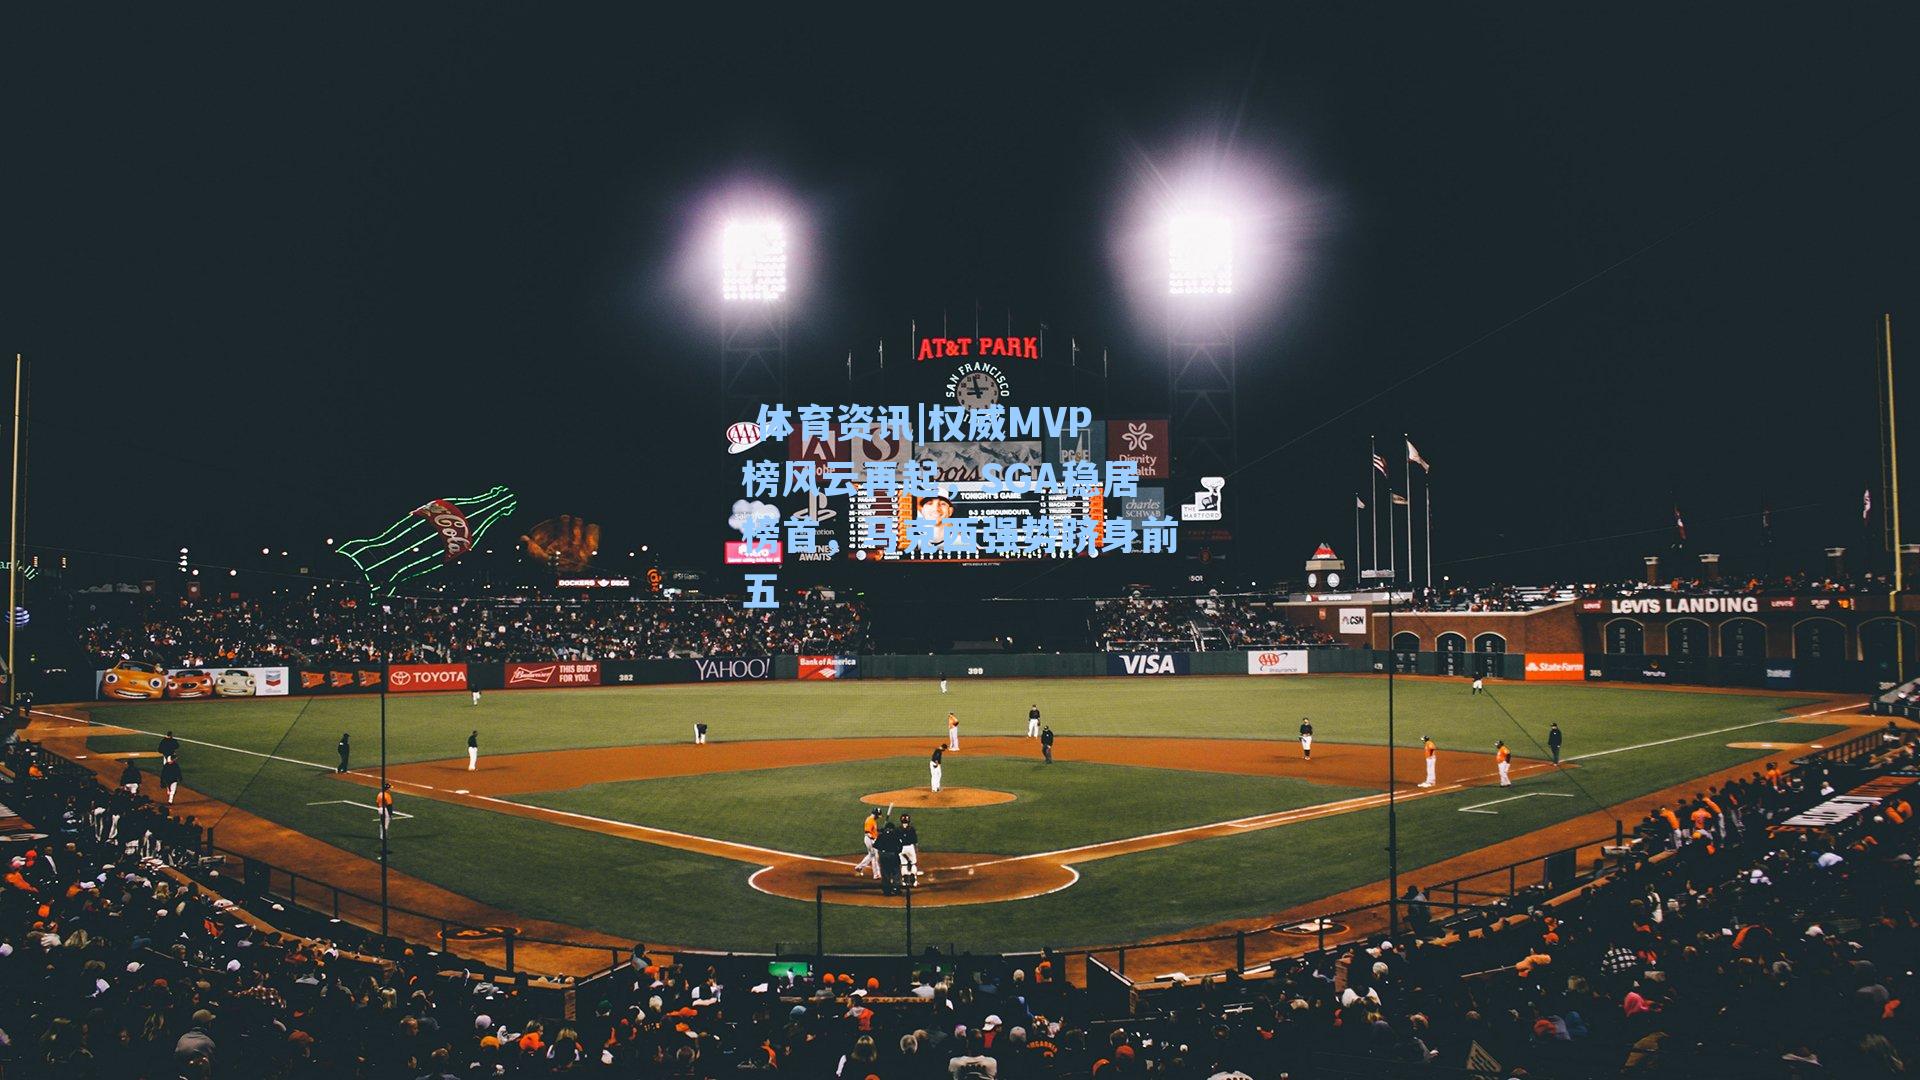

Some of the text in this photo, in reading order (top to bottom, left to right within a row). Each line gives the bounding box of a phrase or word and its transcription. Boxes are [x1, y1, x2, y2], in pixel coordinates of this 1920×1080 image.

[918, 337, 1038, 360] AT&T PARK
[946, 361, 1010, 398] SAN FRANCISCO
[1061, 450, 1089, 461] PG&E
[1125, 499, 1160, 509] charles
[1125, 510, 1160, 518] SCHWAB
[799, 553, 832, 561] AWAITS
[1666, 597, 1758, 613] LANDING
[1349, 616, 1364, 625] CSN
[800, 657, 856, 666] Bank of America
[1119, 654, 1176, 675] VISA
[1258, 653, 1279, 666] AAA
[559, 664, 597, 673] THIS BUD'S
[695, 658, 770, 681] YAHOO!
[413, 671, 466, 683] TOYOTA
[559, 673, 590, 682] FOR YOU.
